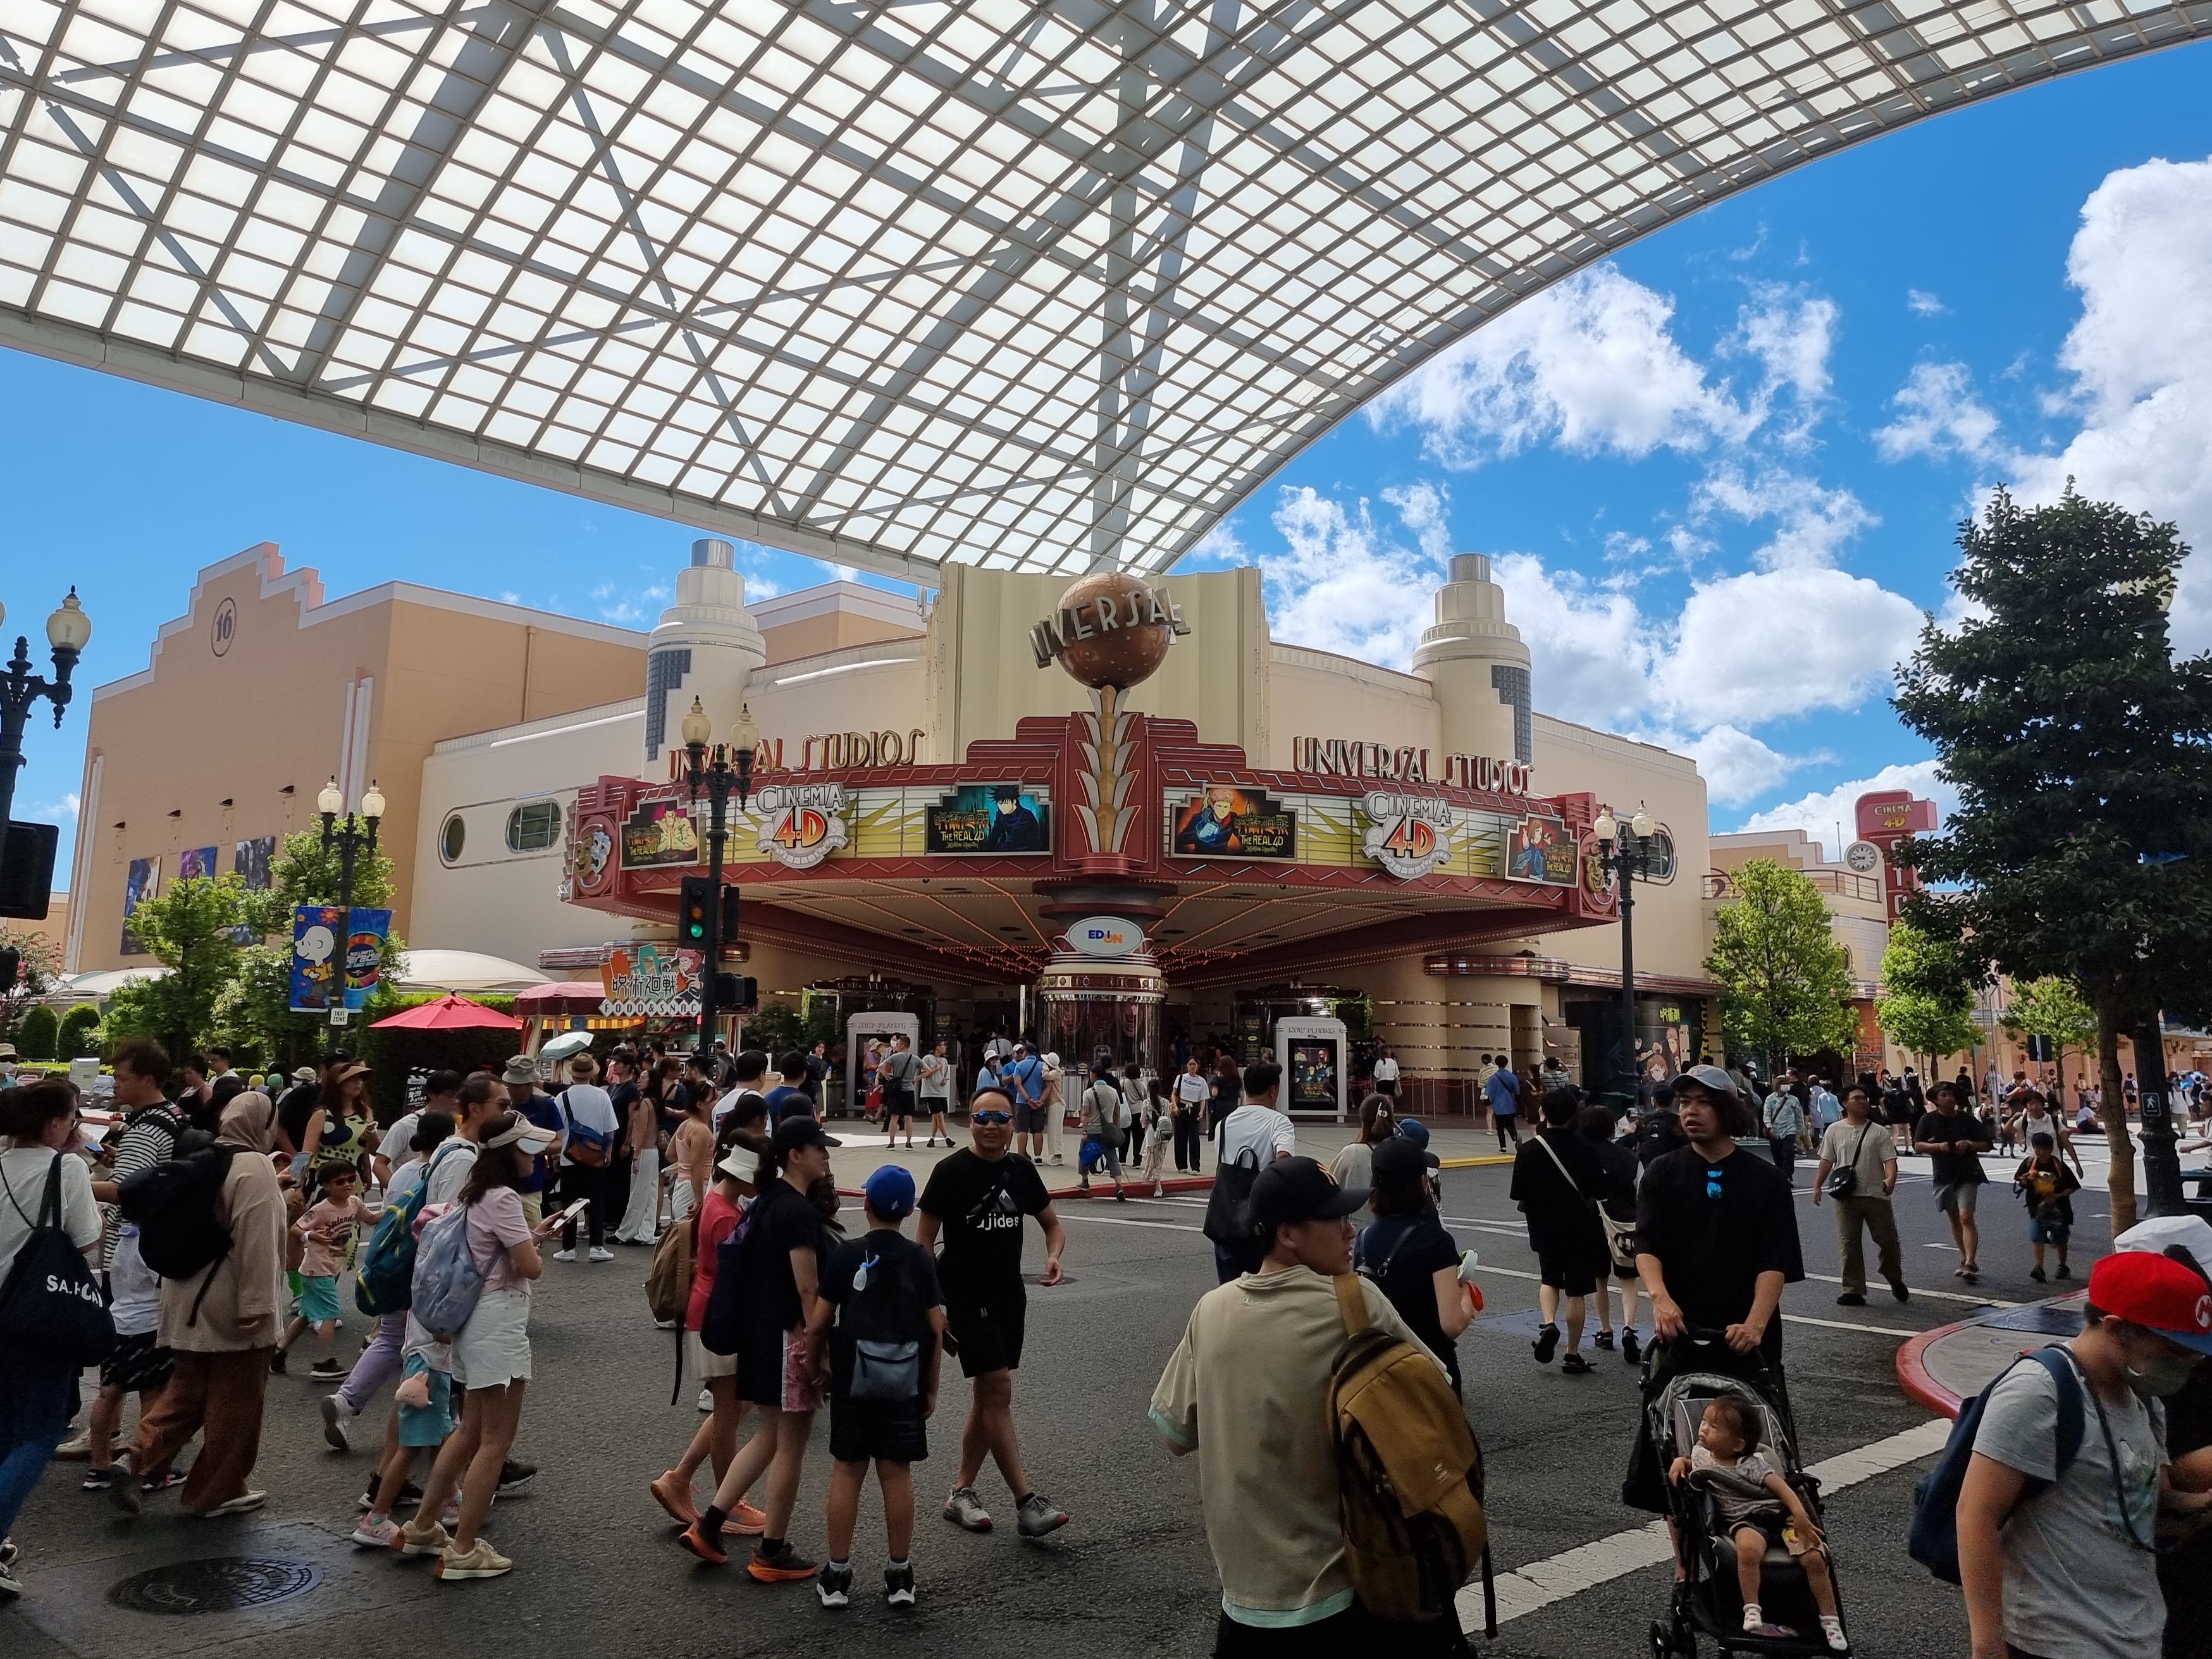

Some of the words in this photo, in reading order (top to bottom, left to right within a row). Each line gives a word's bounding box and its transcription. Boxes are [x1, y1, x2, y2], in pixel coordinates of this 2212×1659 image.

[216, 608, 232, 642] 16
[793, 728, 925, 770] STUDIOS
[1292, 736, 1440, 784] UNIVERSAL
[1443, 751, 1536, 797] STUDIOS
[756, 782, 844, 814] CINEMA
[1367, 791, 1452, 823] CINEMA
[1874, 804, 1913, 817] CINEMA
[612, 974, 676, 997] 呪術廻戦
